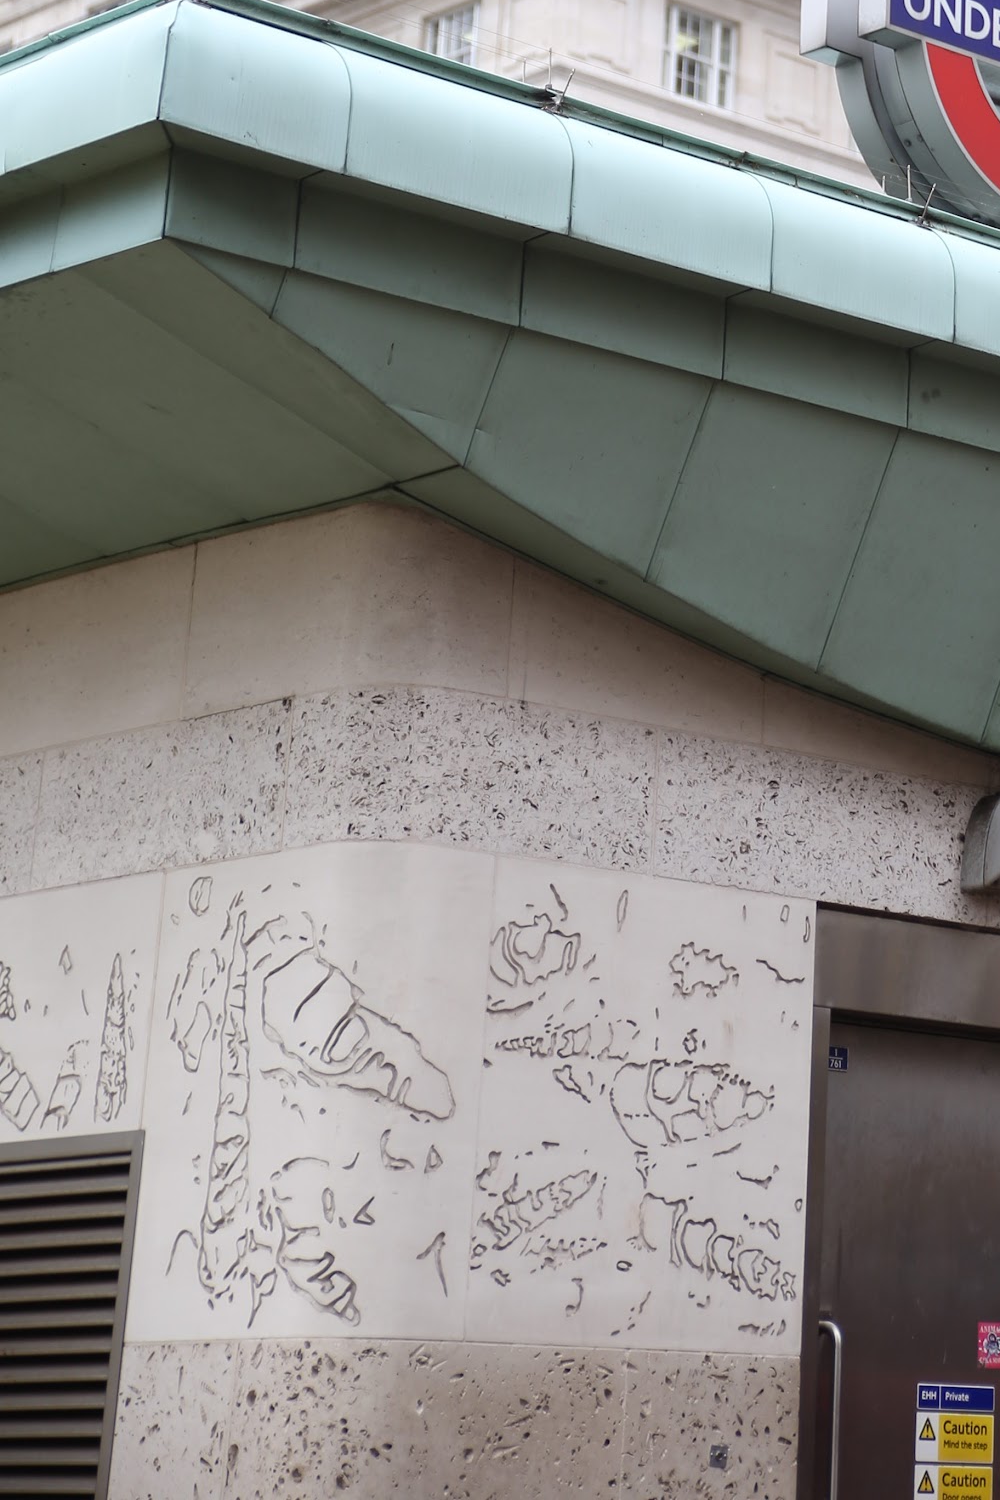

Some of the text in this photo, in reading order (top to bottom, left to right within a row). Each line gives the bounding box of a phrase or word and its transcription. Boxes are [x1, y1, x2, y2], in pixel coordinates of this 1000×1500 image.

[830, 1059, 842, 1069] 761
[921, 1390, 937, 1401] EHH
[945, 1391, 970, 1402] Private
[943, 1420, 988, 1436] Caution
[943, 1440, 988, 1452] Mind the step
[942, 1472, 986, 1488] Caution
